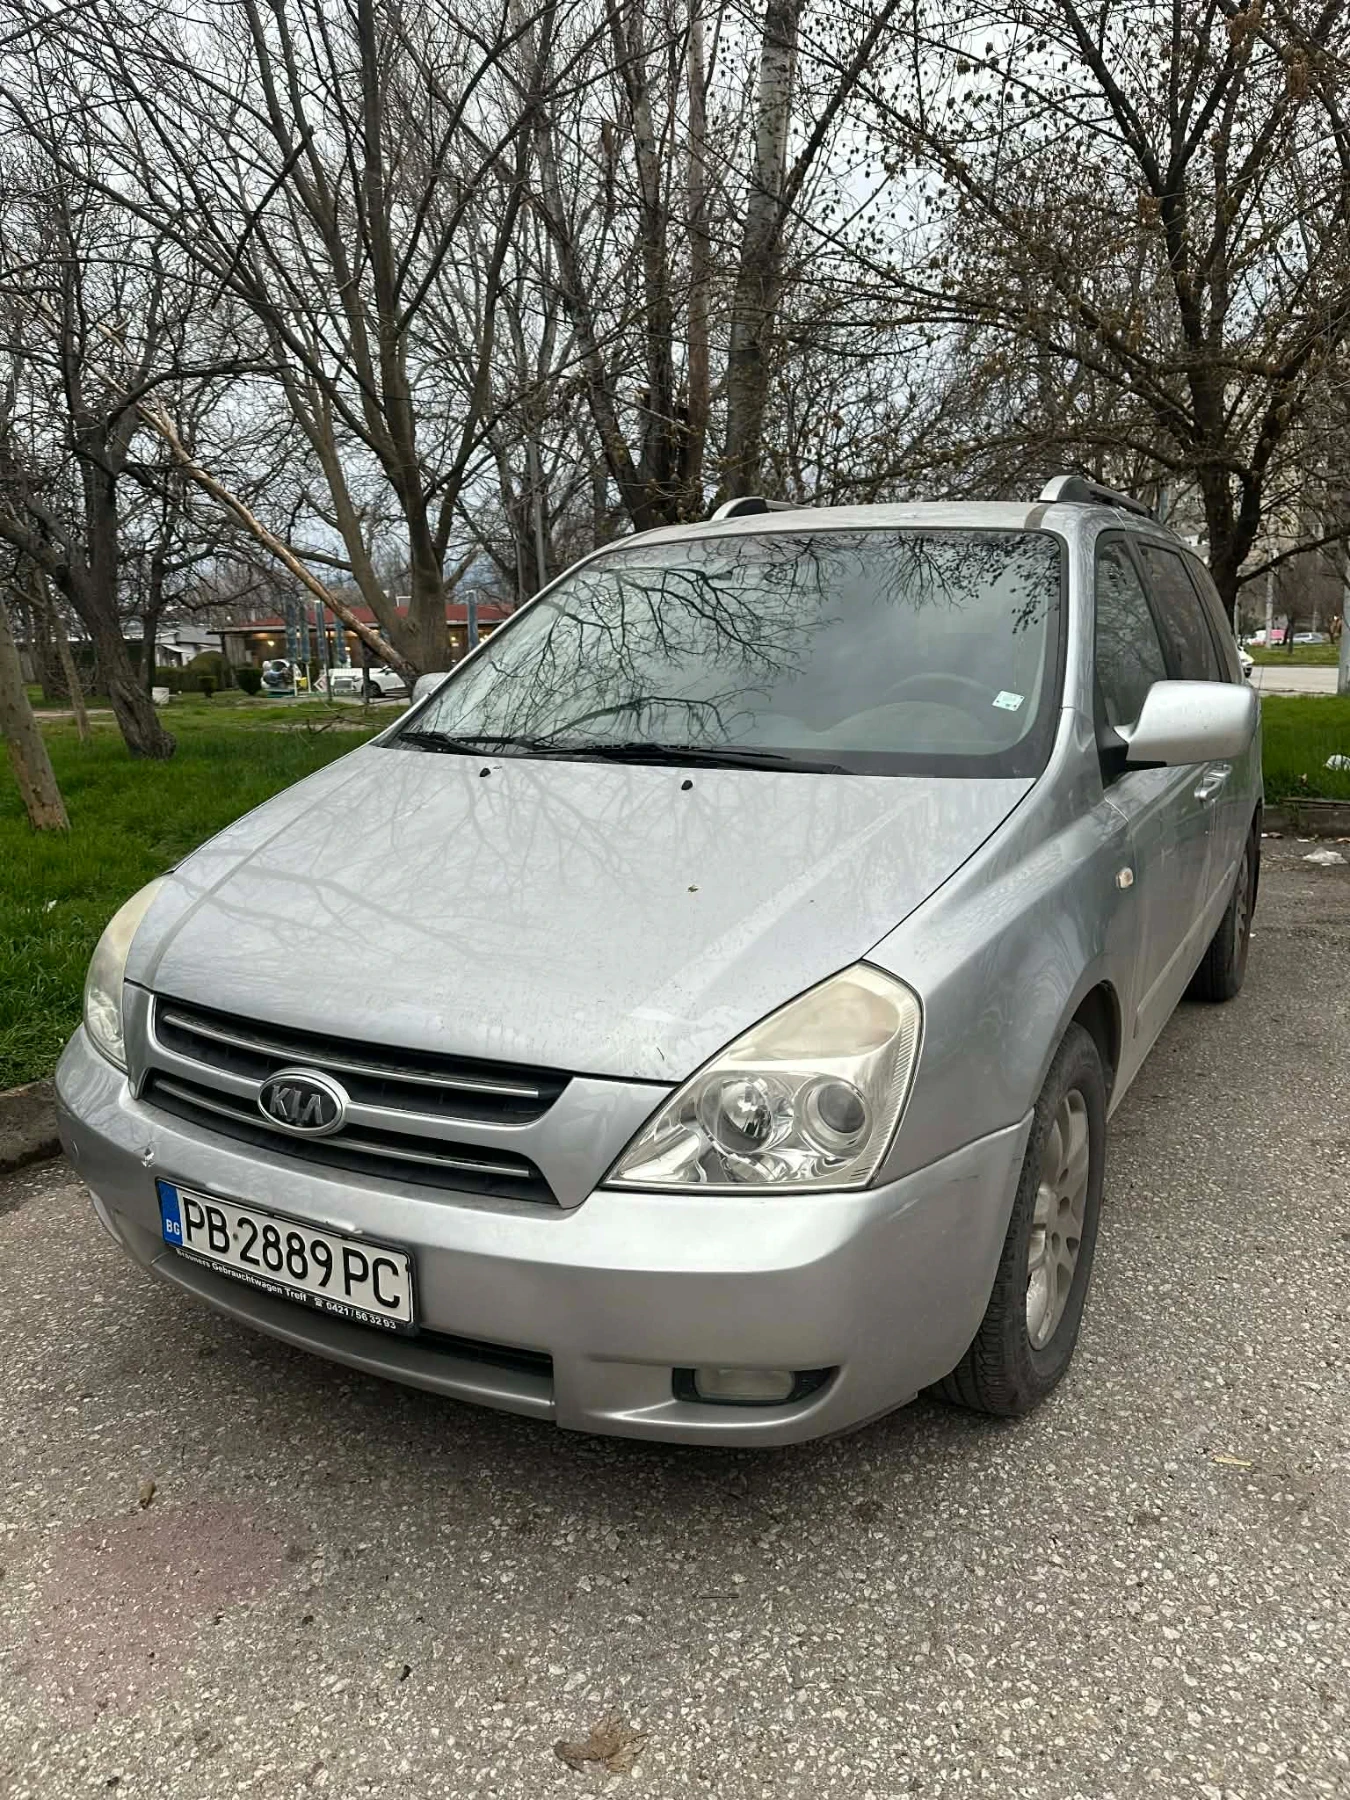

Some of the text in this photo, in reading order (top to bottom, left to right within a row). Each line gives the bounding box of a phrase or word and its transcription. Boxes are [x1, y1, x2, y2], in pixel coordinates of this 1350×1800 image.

[269, 1084, 324, 1125] KIA
[166, 1218, 180, 1235] BG
[183, 1196, 401, 1309] PB 2889 PC
[212, 1261, 283, 1295] Gebrauchtwagen
